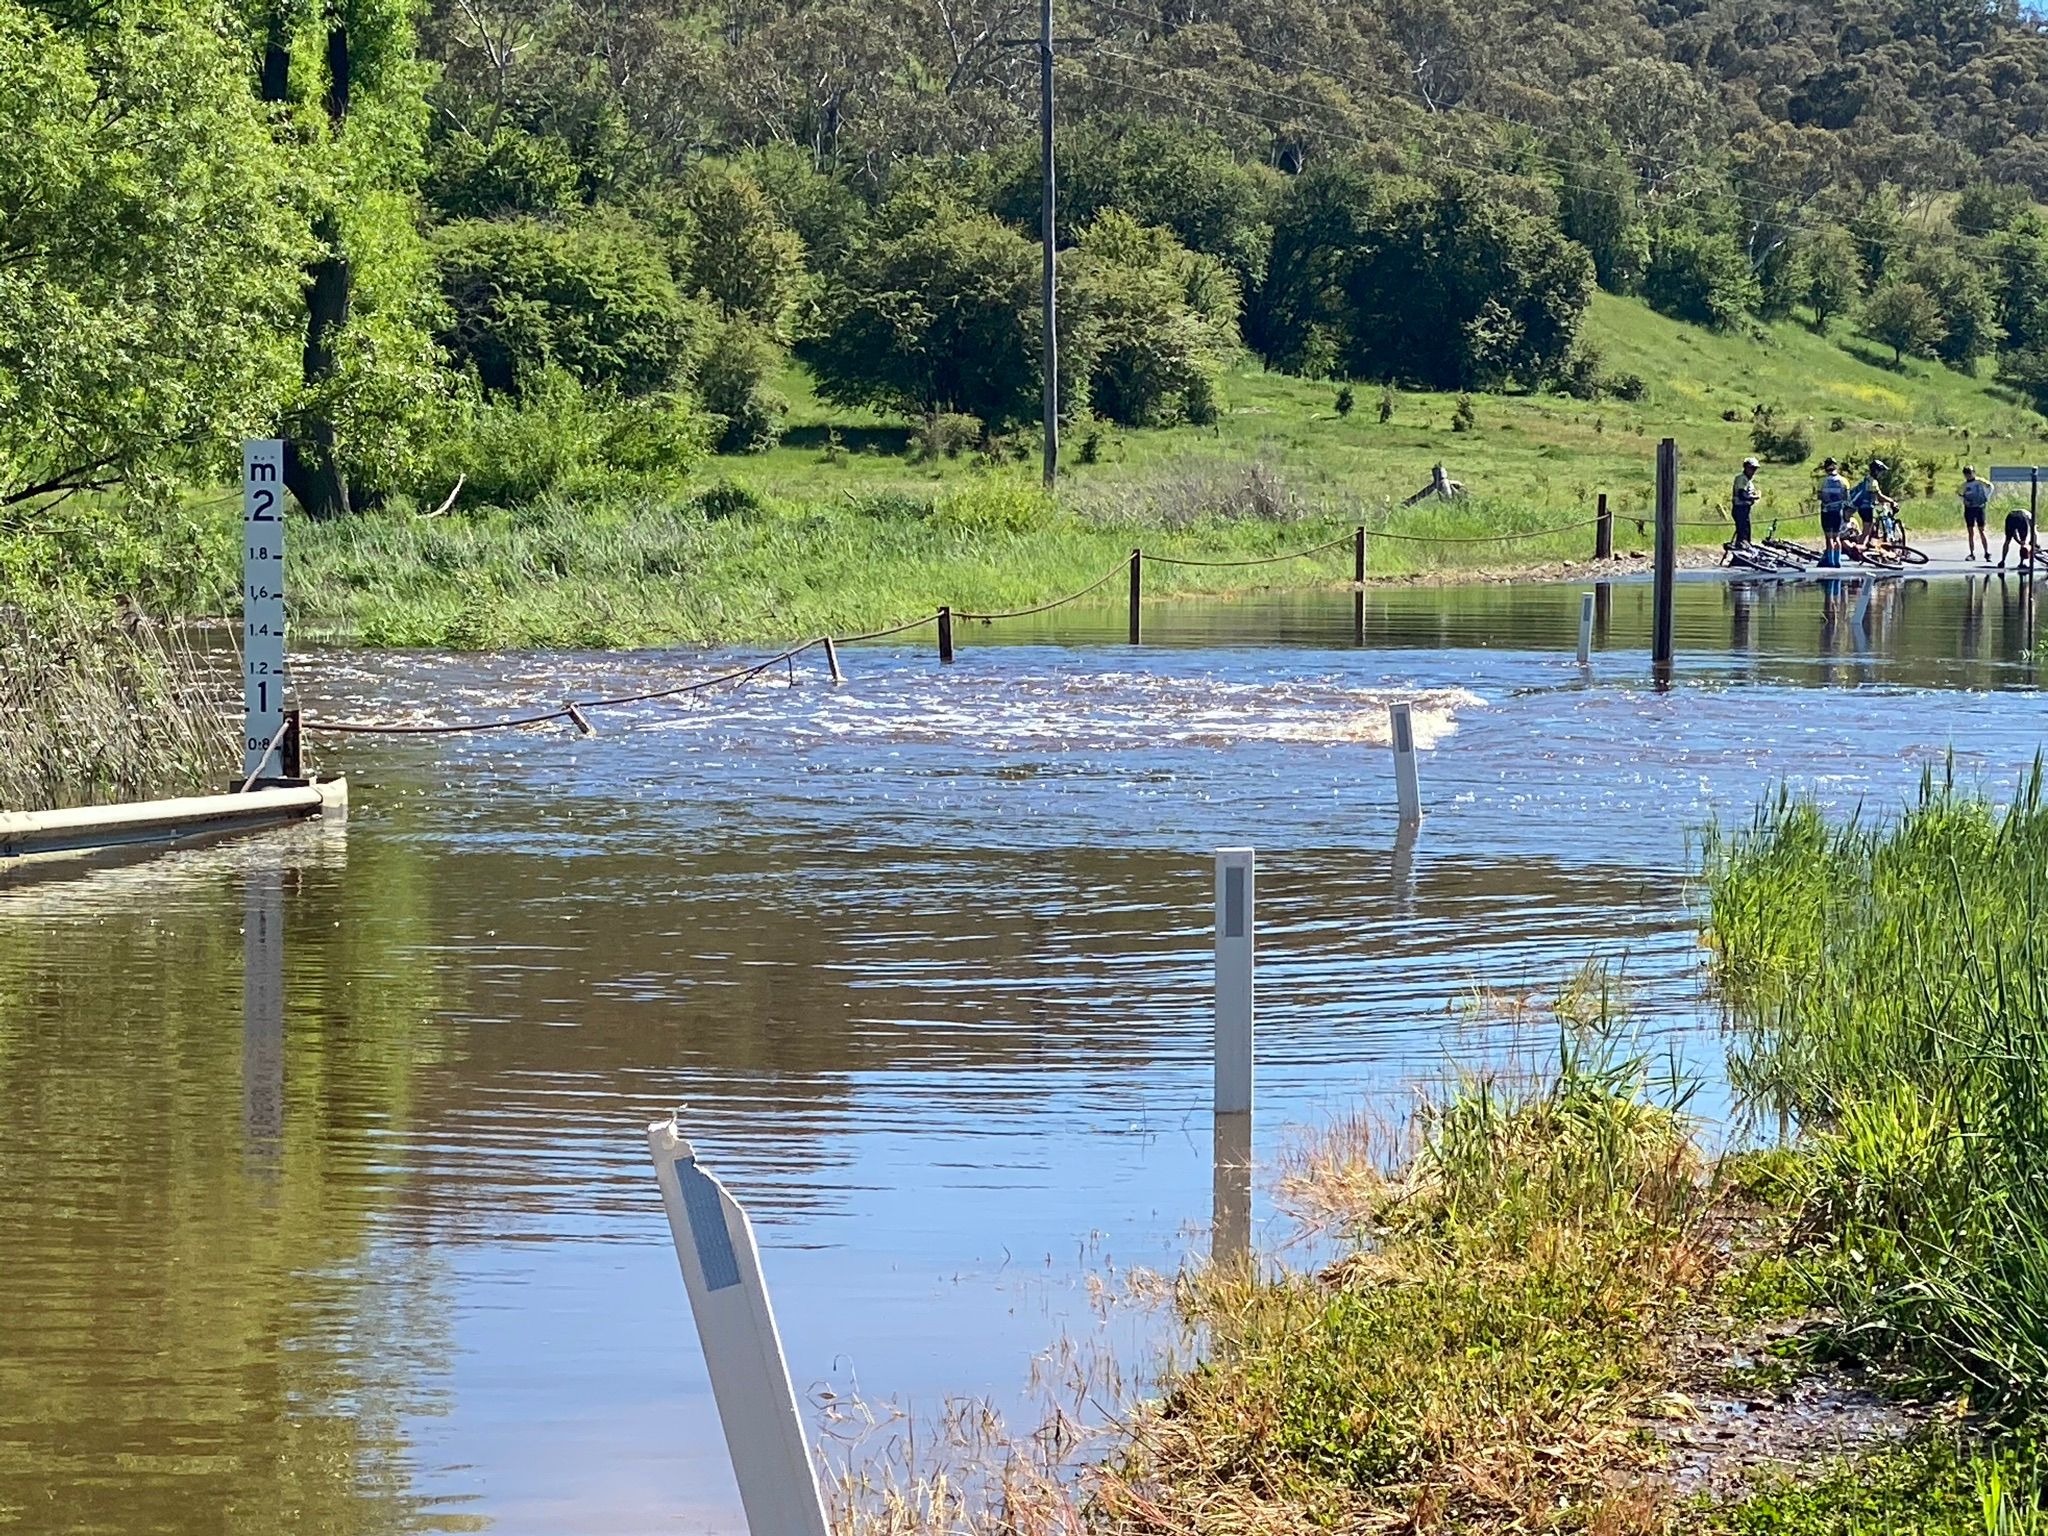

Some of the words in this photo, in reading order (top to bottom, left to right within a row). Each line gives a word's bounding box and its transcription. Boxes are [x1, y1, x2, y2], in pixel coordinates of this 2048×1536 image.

[251, 463, 276, 482] m
[253, 489, 274, 522] 2
[250, 547, 268, 560] 1.8
[250, 624, 268, 637] 1.4
[250, 662, 268, 675] 1.2
[258, 681, 267, 713] 1
